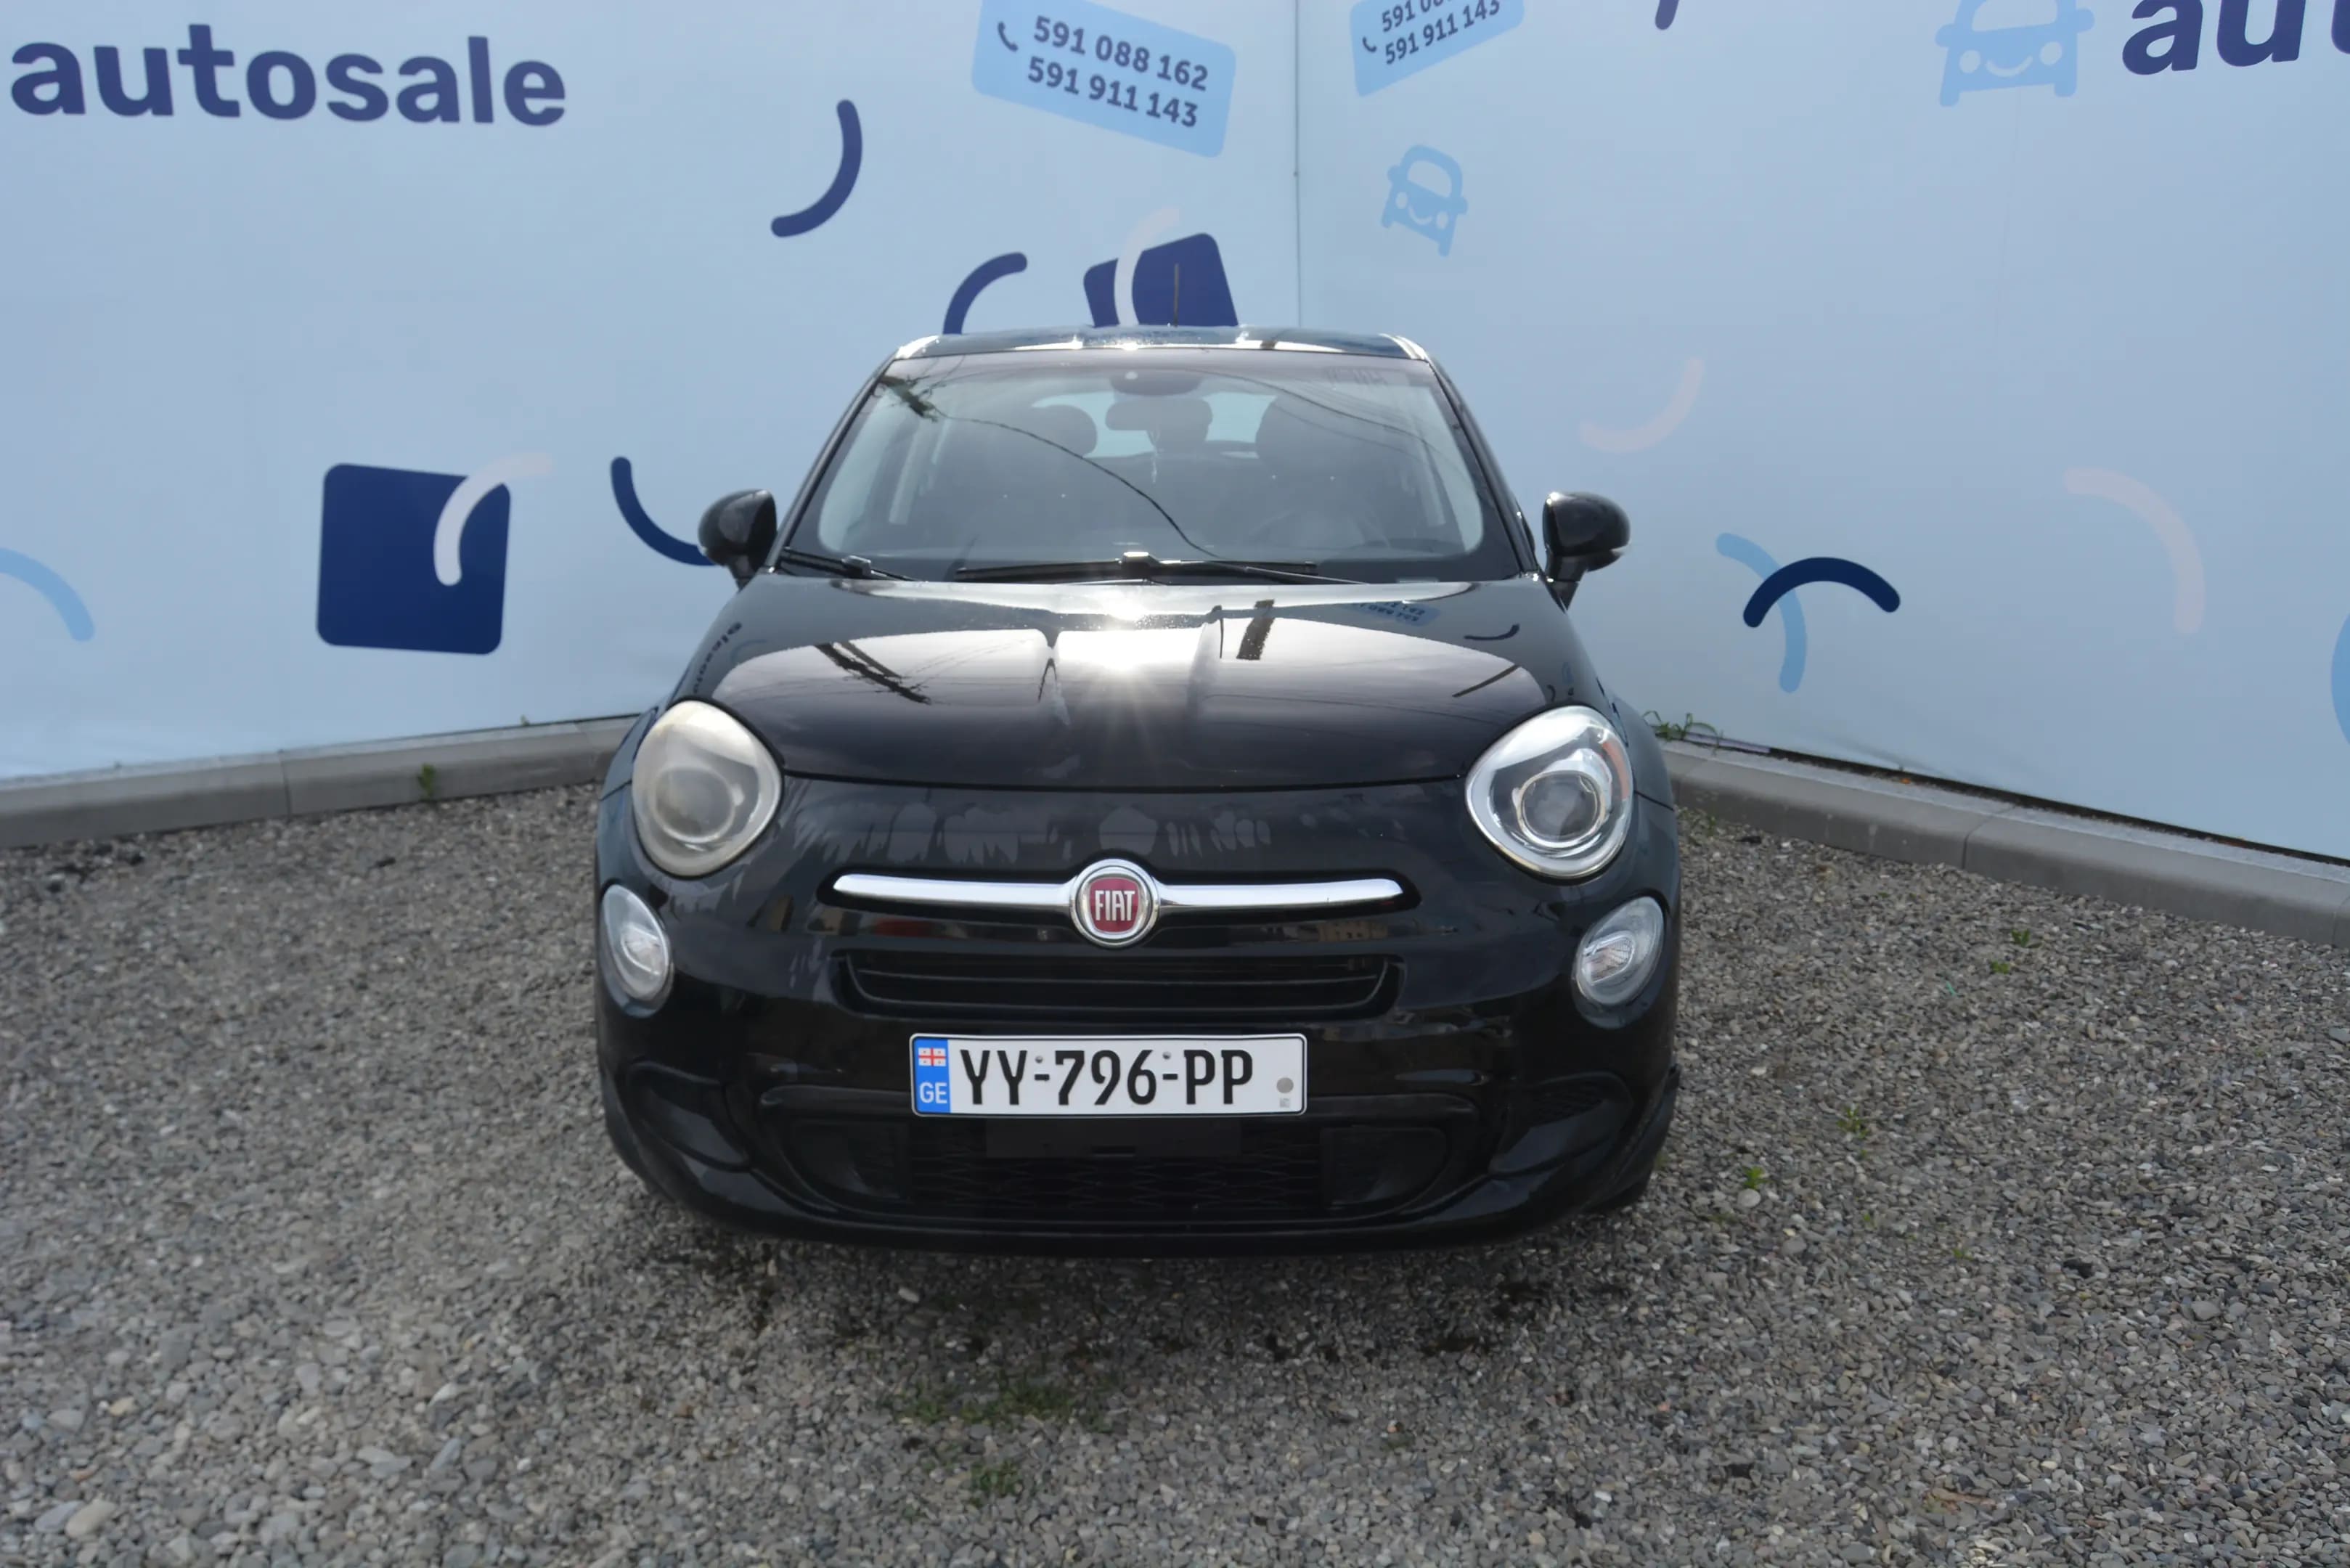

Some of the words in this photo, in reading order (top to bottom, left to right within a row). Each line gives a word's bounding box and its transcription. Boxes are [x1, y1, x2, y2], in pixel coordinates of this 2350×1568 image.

[1382, 0, 1416, 33] 591
[1385, 32, 1419, 65] 591
[1422, 12, 1458, 47] 911
[1462, 0, 1500, 29] 143
[10, 23, 566, 126] autosale
[1034, 15, 1086, 55] 591
[1096, 35, 1150, 73] 088
[1156, 54, 1208, 91] 162
[1027, 56, 1080, 95] 591
[1088, 75, 1138, 113] 911
[1146, 91, 1199, 128] 143
[1095, 890, 1135, 921] FIAT
[919, 1082, 947, 1104] GE
[960, 1049, 1253, 1106] YY-796-PP
